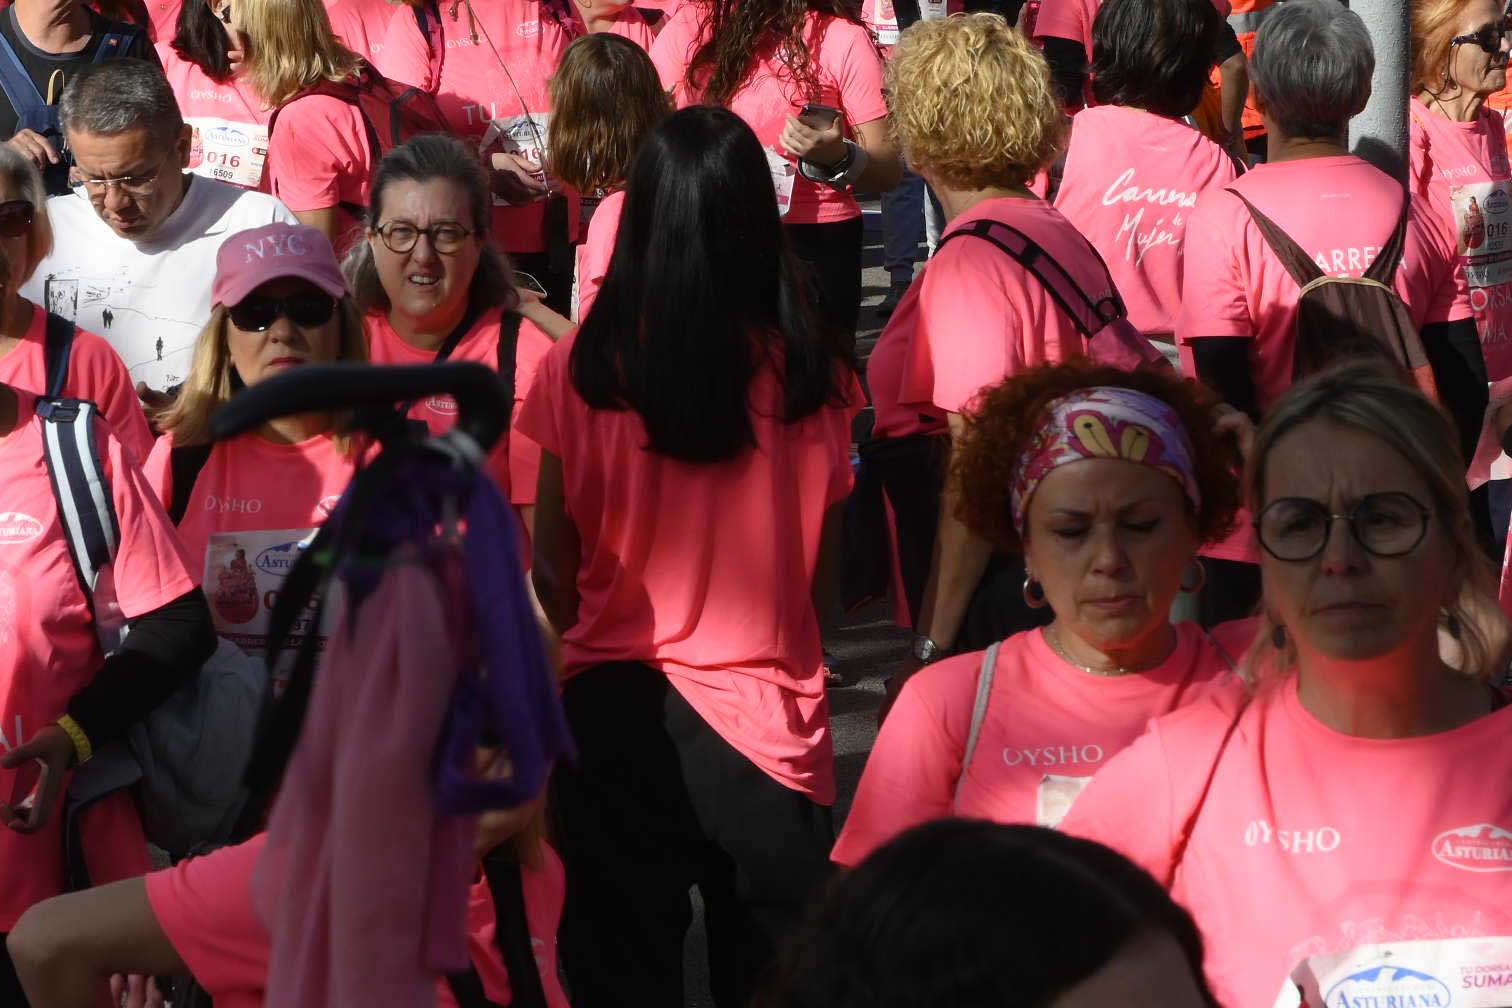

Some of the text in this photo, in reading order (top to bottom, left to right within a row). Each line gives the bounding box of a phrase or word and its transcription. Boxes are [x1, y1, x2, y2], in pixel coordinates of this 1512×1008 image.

[191, 91, 232, 103] OYSHO
[207, 152, 241, 168] 016
[1115, 208, 1180, 266] Mujer
[1488, 223, 1509, 237] 016
[245, 235, 305, 263] NYC
[1003, 744, 1103, 767] OYSHO
